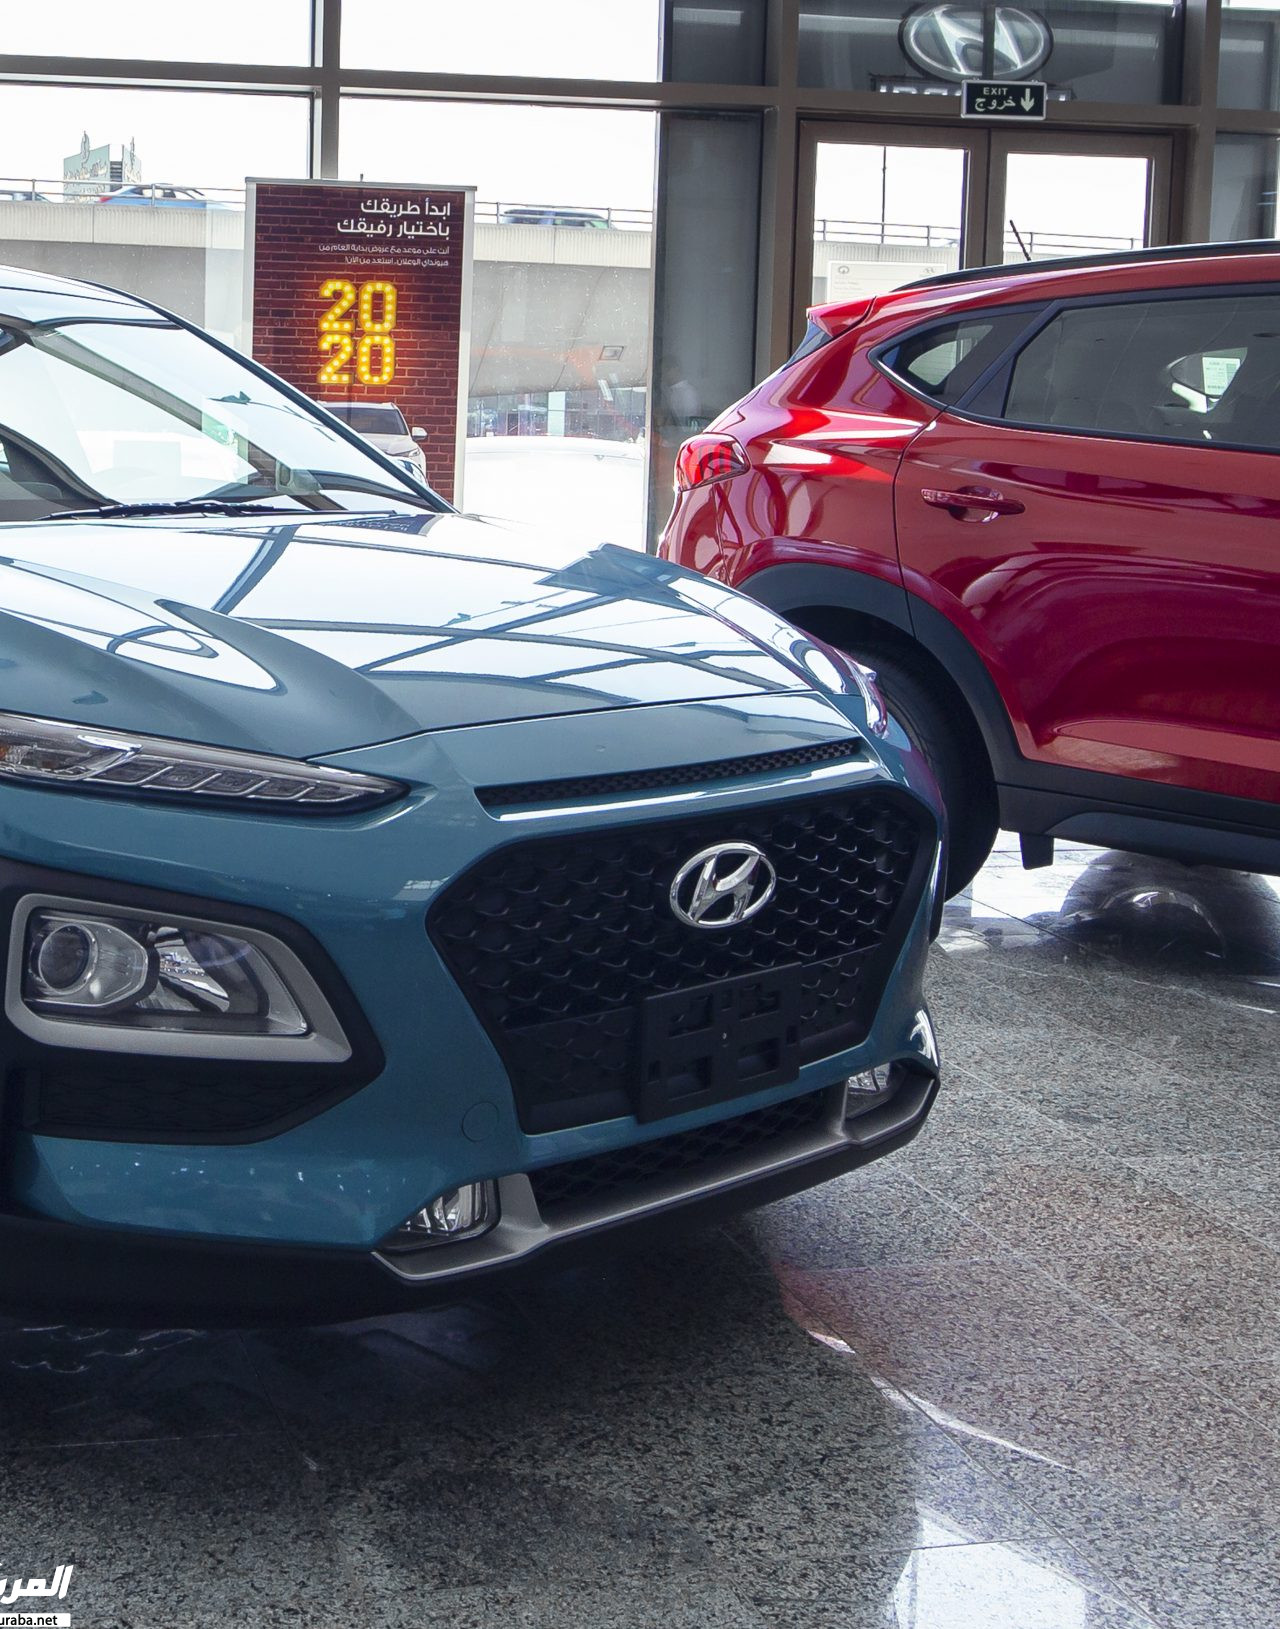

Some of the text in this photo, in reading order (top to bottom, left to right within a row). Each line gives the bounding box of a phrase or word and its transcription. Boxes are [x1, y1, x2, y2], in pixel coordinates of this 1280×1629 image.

[983, 87, 1008, 96] EXIT
[974, 95, 1016, 112] خروج
[360, 198, 451, 220] ابدأ طريقك
[337, 218, 450, 240] باختيار رفيقك
[318, 243, 331, 252] من
[331, 243, 351, 252] العام
[351, 244, 368, 252] بداية
[368, 245, 389, 253] عروض
[389, 245, 402, 254] مع
[402, 246, 422, 254] موعد
[437, 245, 450, 255] أنت
[359, 256, 371, 265] من
[318, 279, 398, 333] 20
[316, 333, 396, 385] 20
